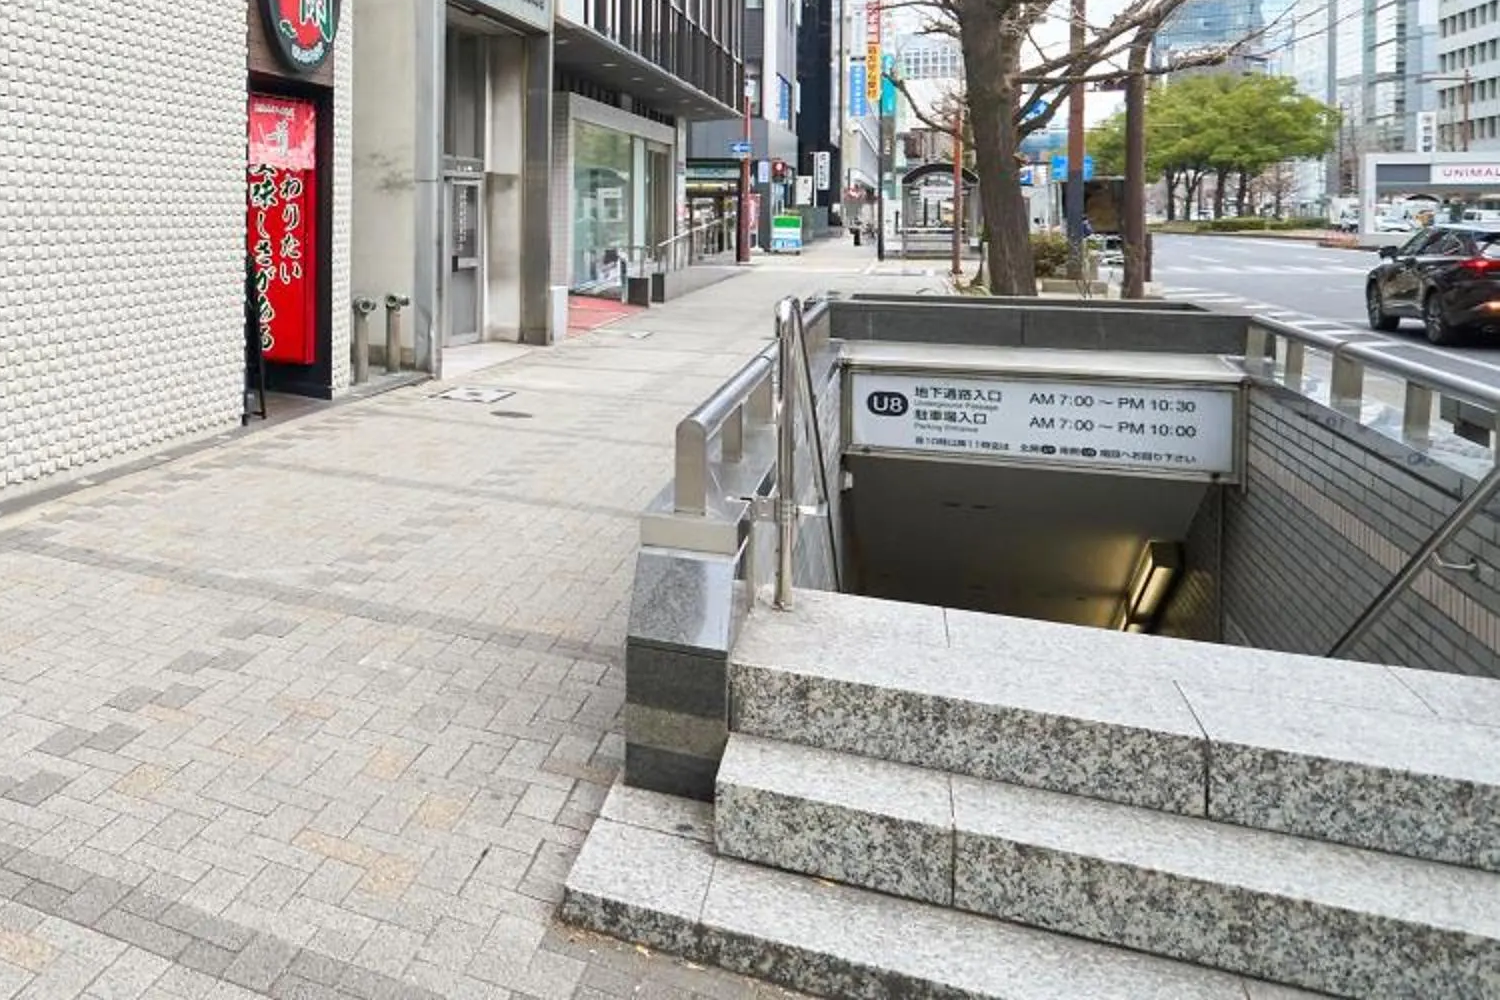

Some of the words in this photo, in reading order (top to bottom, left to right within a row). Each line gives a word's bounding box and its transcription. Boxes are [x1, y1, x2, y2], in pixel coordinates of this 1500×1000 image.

[914, 386, 1002, 401] 地下通路入口
[872, 396, 902, 413] U8
[1029, 393, 1055, 406] AM
[1060, 394, 1095, 407] 7:00
[1118, 397, 1145, 410] PM
[1151, 400, 1197, 413] 10:30
[914, 409, 987, 425] 駐車場入口
[1029, 417, 1055, 429] AM
[1060, 418, 1095, 431] 7:00
[1118, 421, 1145, 435] PM
[1151, 424, 1197, 437] 10:00
